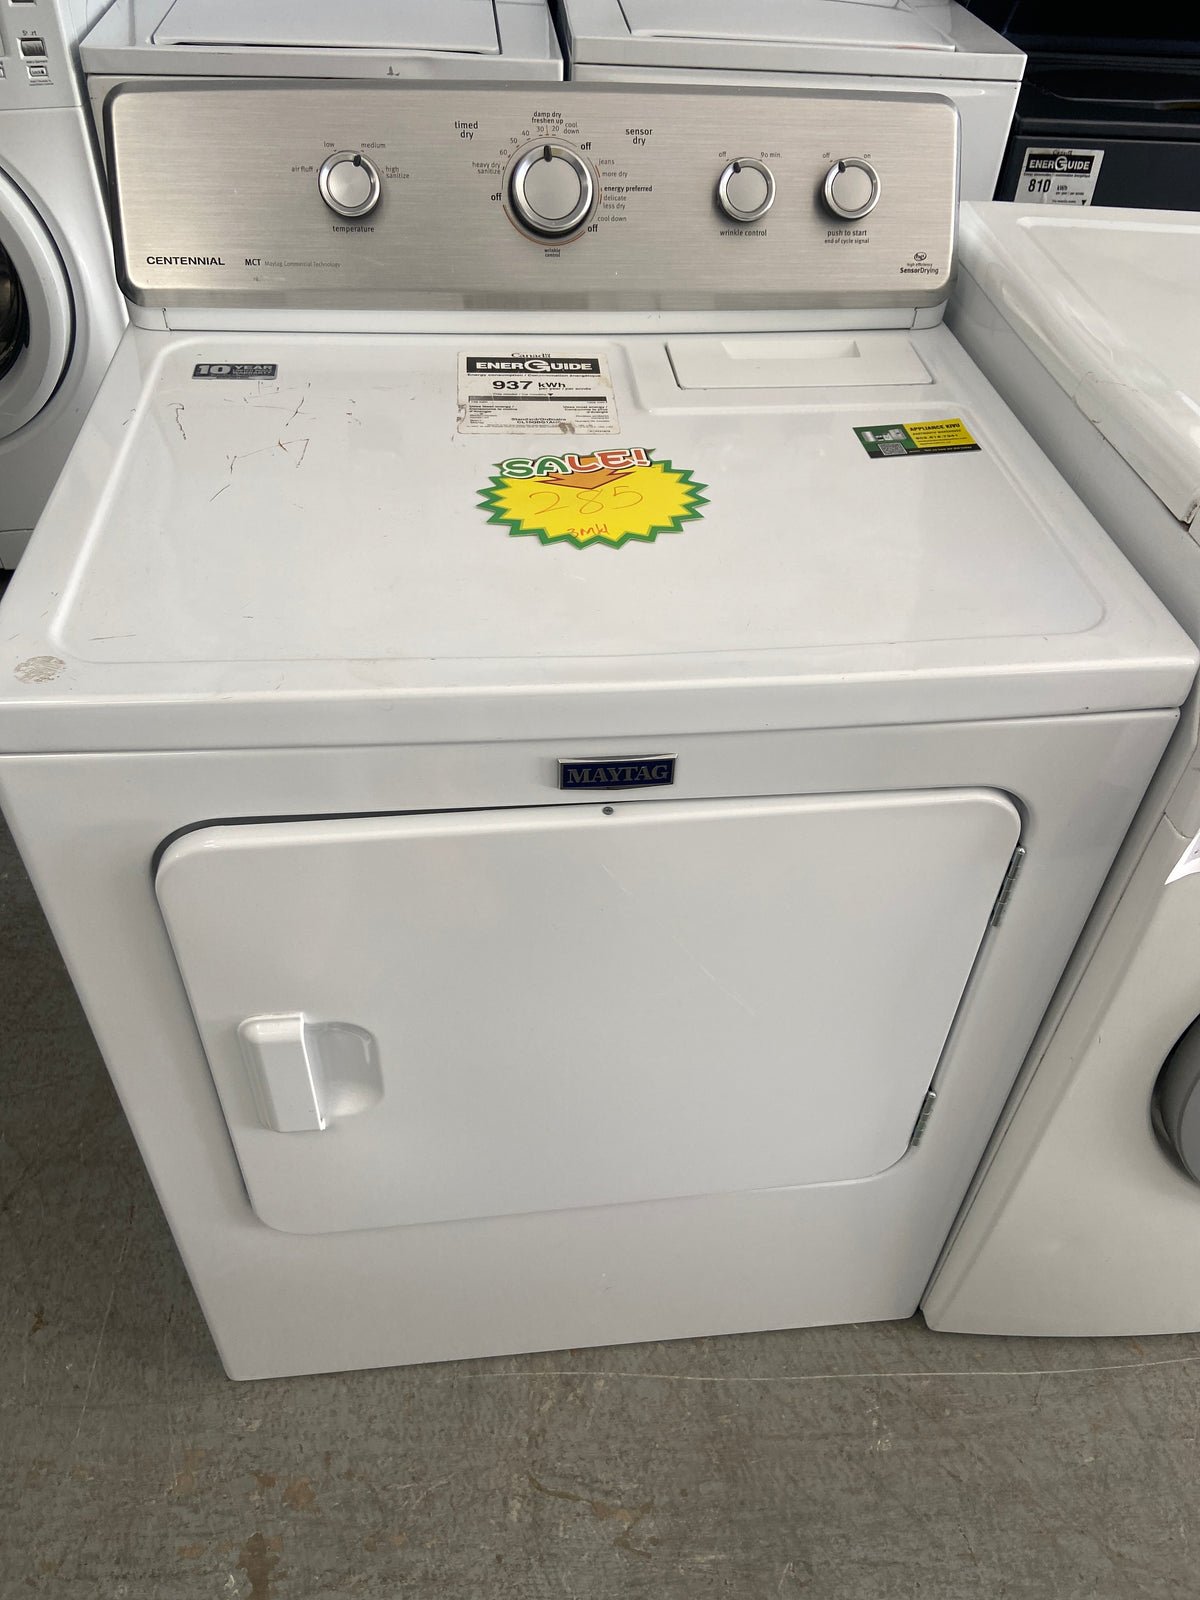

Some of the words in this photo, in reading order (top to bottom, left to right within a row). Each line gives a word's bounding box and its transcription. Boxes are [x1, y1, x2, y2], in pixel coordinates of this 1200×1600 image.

[551, 111, 562, 119] dry
[454, 121, 479, 130] timed
[460, 130, 474, 140] dry
[632, 136, 646, 145] dry
[580, 142, 592, 151] off
[769, 151, 783, 159] min.
[598, 158, 615, 166] jeans
[1028, 155, 1091, 172] ENERGUIDE
[300, 165, 314, 173] fluff
[1028, 178, 1052, 193] 810
[490, 192, 503, 202] off
[332, 225, 375, 234] temperature
[587, 223, 598, 232] off
[719, 228, 744, 236] wrinkle
[744, 228, 767, 236] control
[827, 229, 843, 237] push
[146, 256, 226, 266] CENTENNIAL
[245, 258, 261, 266] MCT
[899, 267, 939, 275] SensorDrying
[198, 365, 231, 374] 10
[475, 359, 593, 373] ENERGUIDE
[492, 380, 533, 390] 937
[538, 381, 566, 389] kWh
[502, 448, 651, 479] SALE!
[528, 485, 644, 515] 285
[566, 764, 673, 784] MAYTAG
